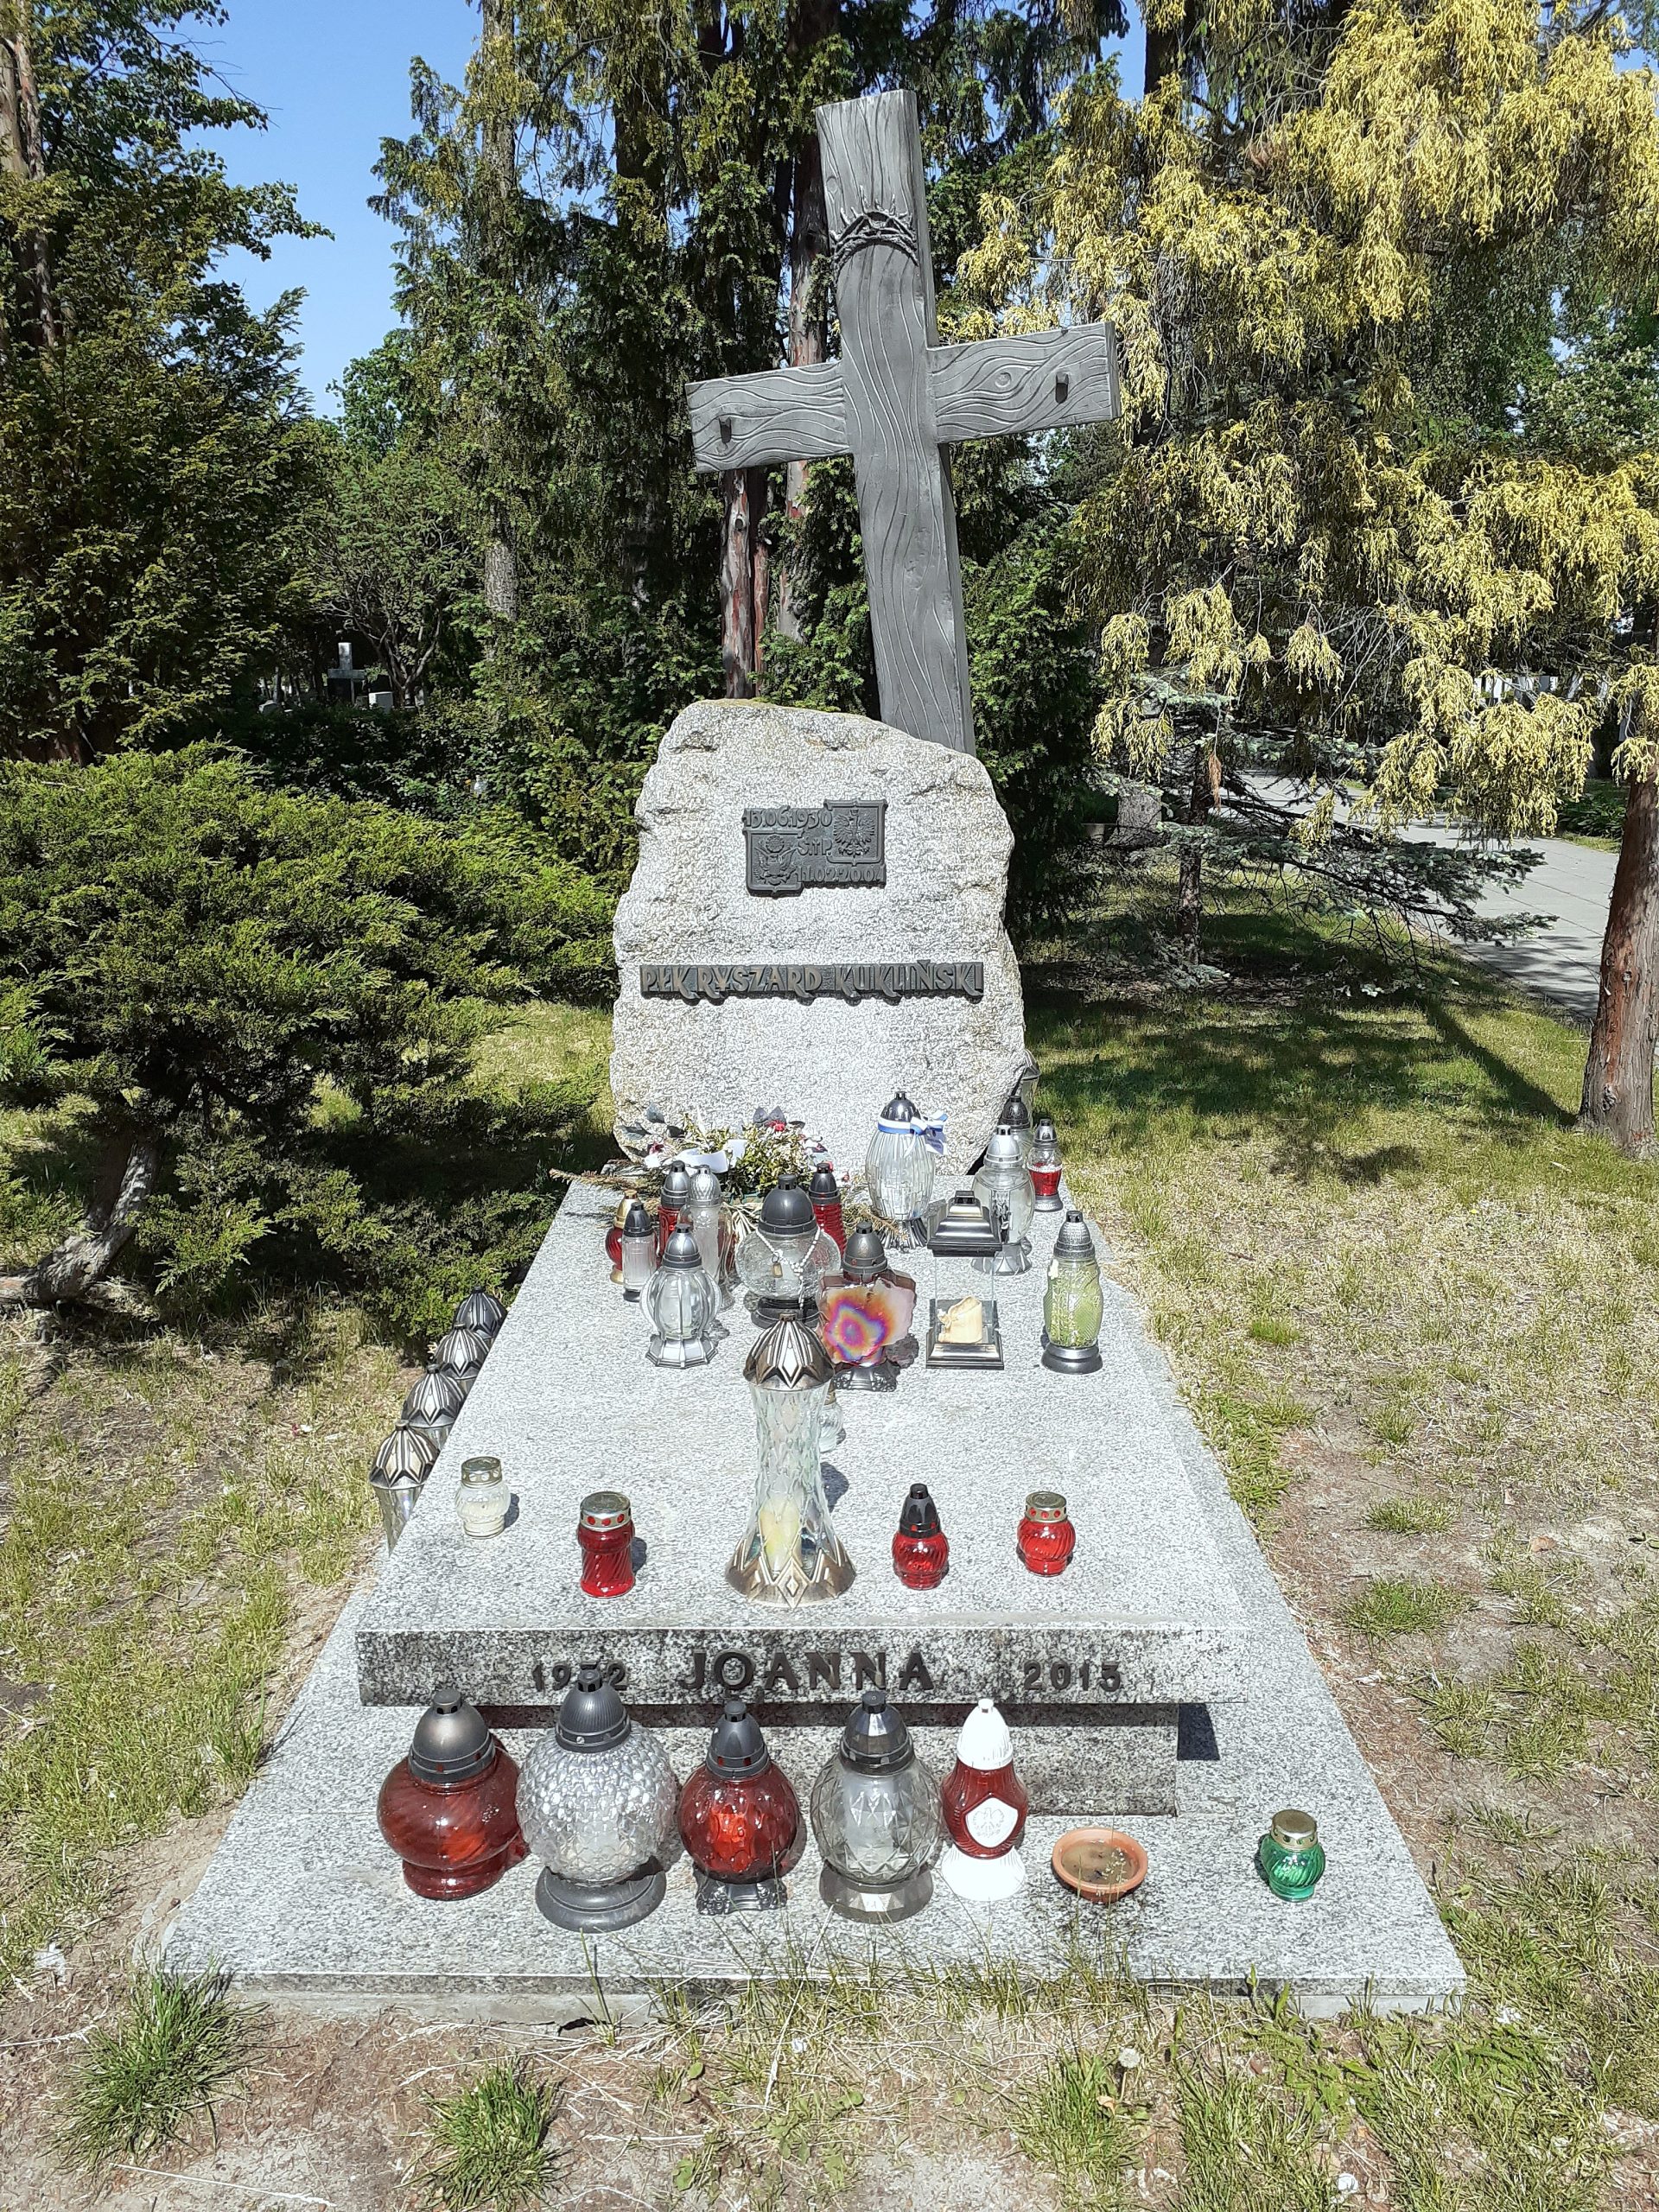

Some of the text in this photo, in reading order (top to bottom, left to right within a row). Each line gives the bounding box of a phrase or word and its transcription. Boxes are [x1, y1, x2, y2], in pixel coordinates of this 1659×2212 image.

[697, 965, 823, 999] RYSZARD
[835, 960, 984, 997] KUKLIŃSKI
[687, 1649, 935, 1690] JOANNA
[1023, 1659, 1122, 1693] 2013
